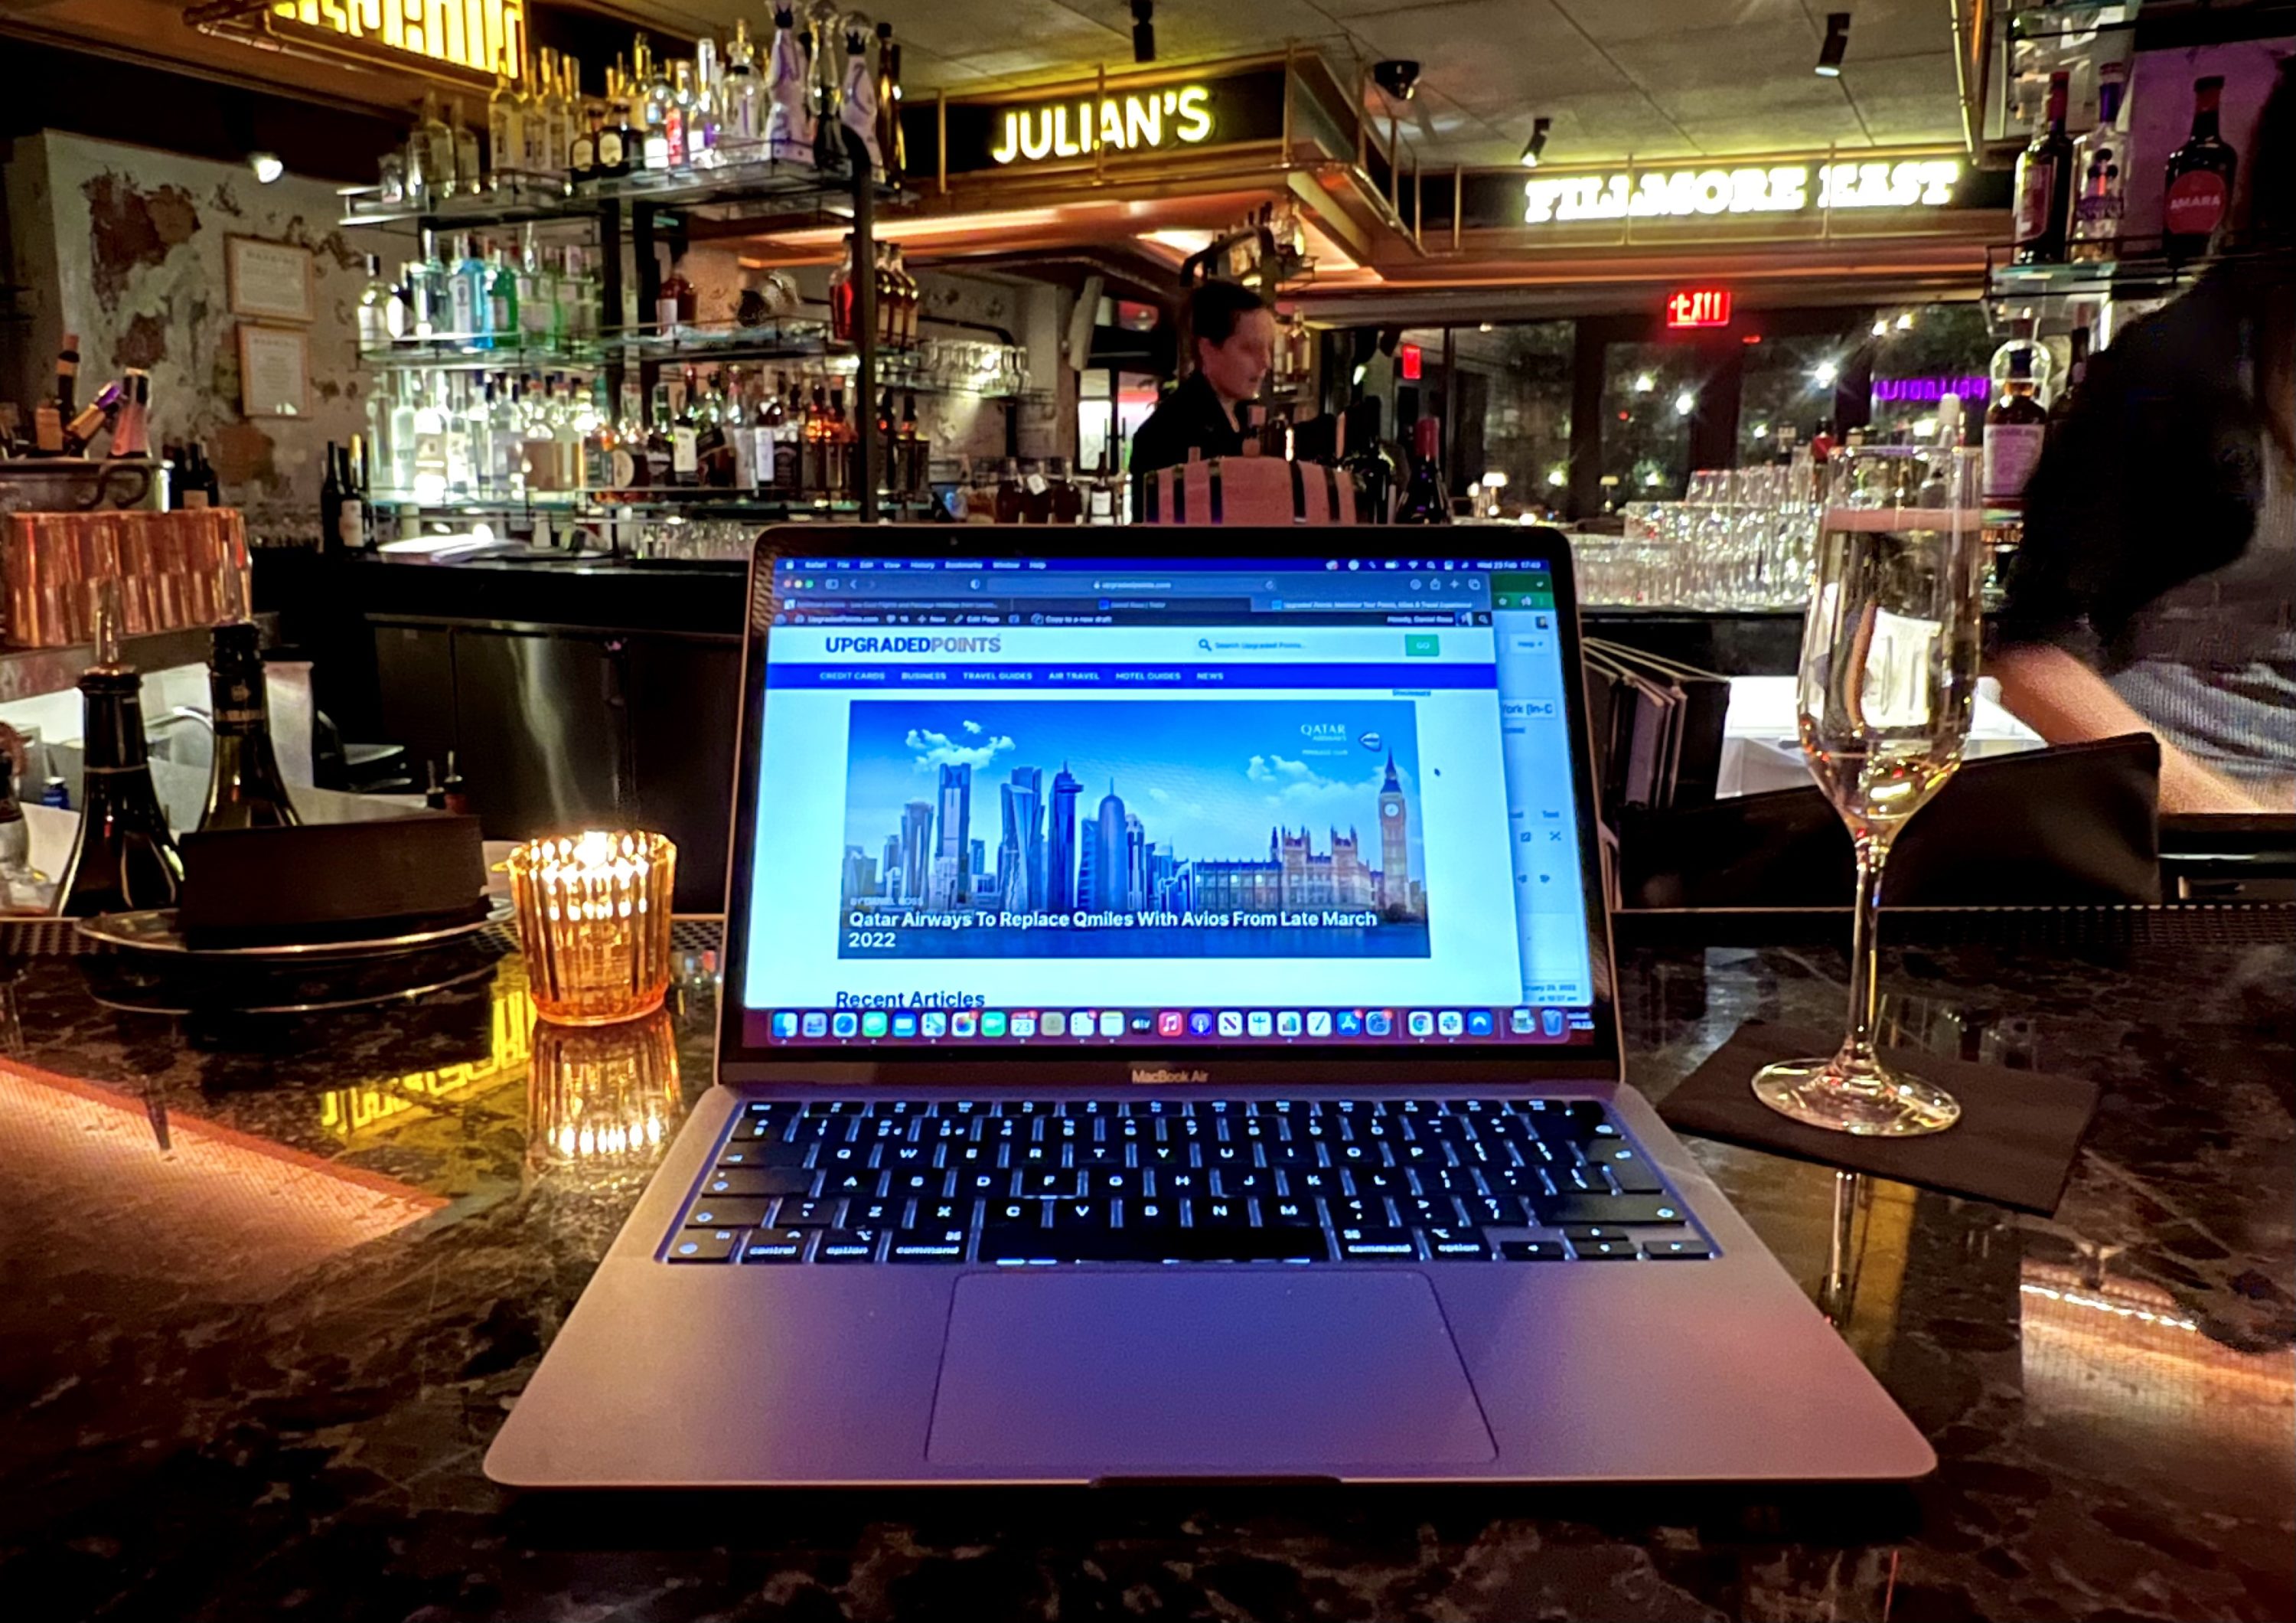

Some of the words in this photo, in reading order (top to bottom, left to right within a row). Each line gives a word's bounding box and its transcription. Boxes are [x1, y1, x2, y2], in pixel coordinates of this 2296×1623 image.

[993, 86, 1213, 164] JULIAN'S
[1525, 168, 1808, 223] FILLMORE
[1818, 161, 1958, 208] EAST
[2170, 194, 2221, 210] AMARA
[826, 637, 1001, 653] UPGRADEDPOINTS
[1416, 641, 1430, 650] GO
[820, 672, 852, 681] CREDIT
[854, 672, 885, 681] CARDS
[902, 672, 947, 681] BUSINESS
[963, 672, 996, 681] TRAVEL
[998, 672, 1032, 681] GUIDES
[1049, 672, 1065, 681] AIR
[1066, 672, 1100, 681] TRAVEL
[1115, 672, 1145, 681] HOTEL
[1147, 672, 1182, 681] GUIDES
[1196, 672, 1224, 681] NEWS
[1301, 724, 1345, 736] QATAR
[850, 912, 899, 928] Qatar
[902, 911, 973, 930] Airways
[976, 911, 996, 927] To
[1000, 911, 1069, 929] Replace
[1074, 910, 1133, 928] Qmiles
[1137, 910, 1178, 927] With
[1181, 910, 1229, 927] Avios
[1233, 911, 1277, 927] From
[1280, 911, 1319, 927] Late
[1322, 911, 1378, 927] March
[849, 932, 896, 948] 2022
[837, 991, 905, 1007] Recent
[910, 990, 985, 1007] Articles
[1015, 1021, 1031, 1032] 23
[1132, 1069, 1189, 1083] MacBook
[1191, 1070, 1208, 1083] Air
[749, 1246, 797, 1254] control
[827, 1246, 868, 1255] option
[1438, 1243, 1479, 1252] option
